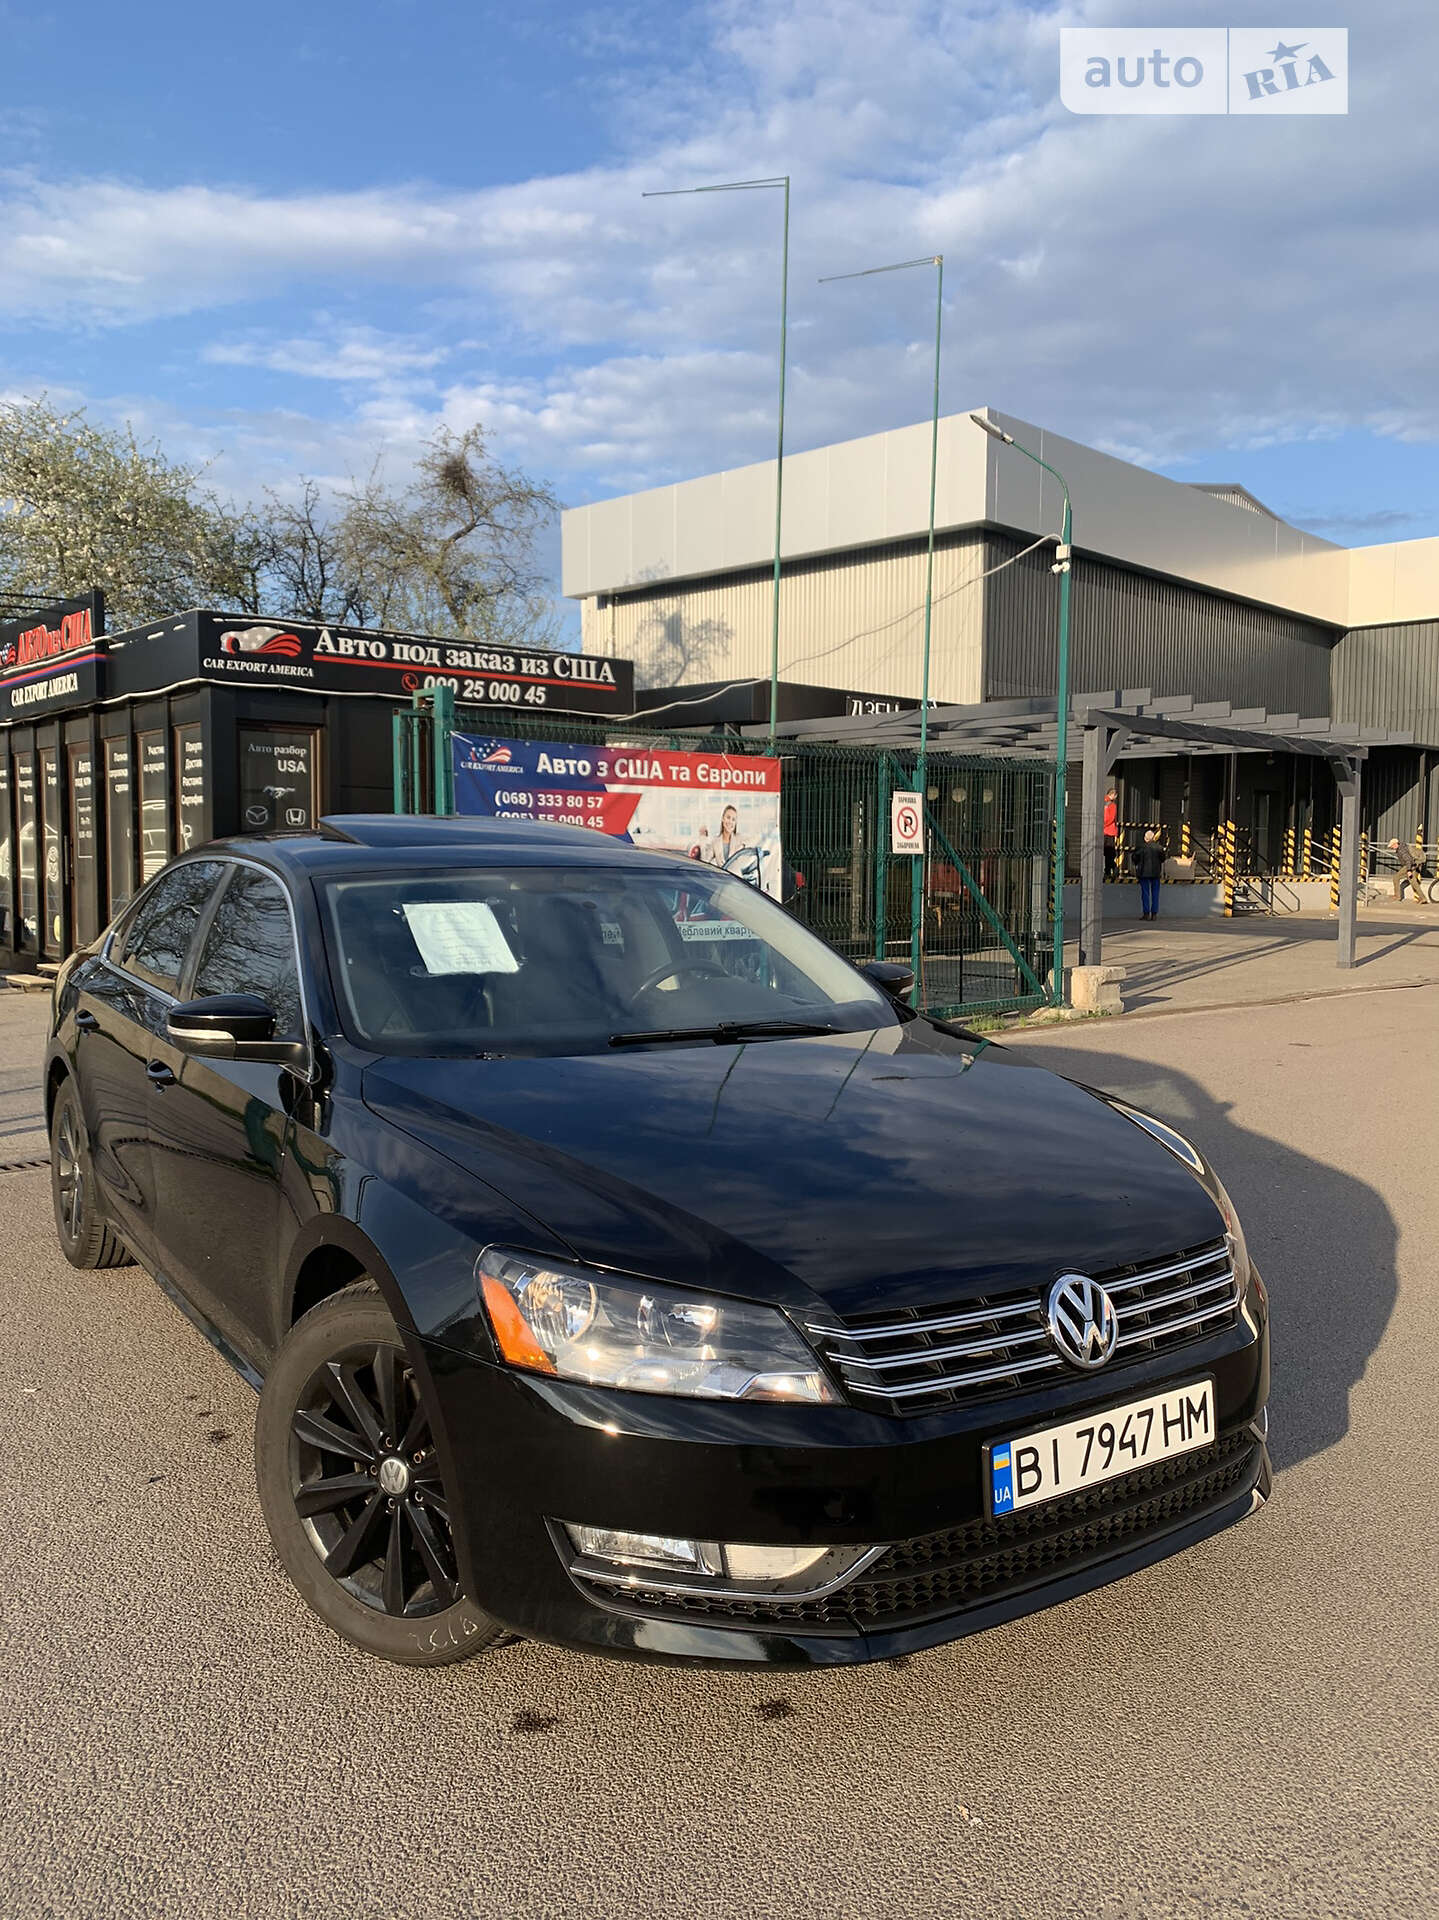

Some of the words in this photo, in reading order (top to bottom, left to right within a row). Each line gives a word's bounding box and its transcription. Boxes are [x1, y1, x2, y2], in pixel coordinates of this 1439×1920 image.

[313, 629, 386, 659] Авто
[392, 643, 441, 667] под
[446, 649, 515, 673] заказ
[521, 658, 549, 676] из
[553, 656, 616, 683] США
[203, 657, 225, 669] CAR
[226, 660, 268, 674] EXPORT
[267, 664, 314, 677] AMERICA
[48, 673, 78, 697] AMERICA
[463, 679, 485, 699] 25
[489, 681, 520, 702] 000
[524, 685, 546, 705] 45
[273, 745, 307, 758] разбор
[277, 759, 307, 773] USA
[536, 752, 591, 777] Авто
[596, 760, 609, 777] з
[613, 758, 664, 781] США
[669, 764, 691, 782] та
[696, 763, 767, 788] Європи
[494, 790, 533, 808] (068)
[537, 793, 563, 807] 333
[566, 795, 583, 807] 80
[586, 796, 604, 808] 57
[587, 816, 604, 828] 45
[1015, 1437, 1060, 1498] BI
[1076, 1407, 1155, 1478] 7947
[1162, 1390, 1209, 1448] HM
[994, 1486, 1012, 1504] UA
